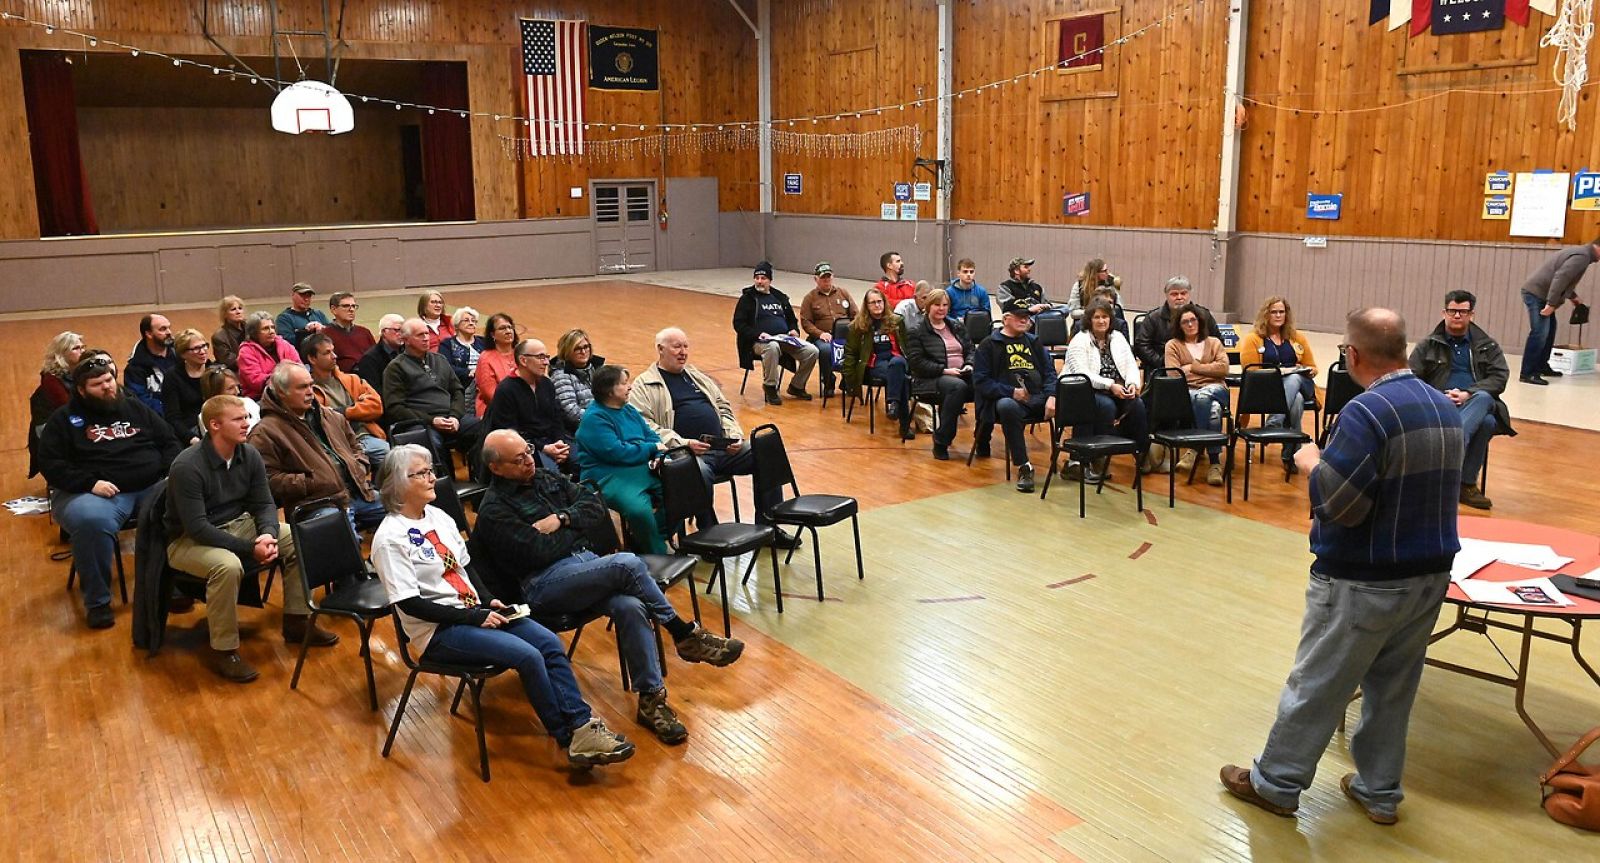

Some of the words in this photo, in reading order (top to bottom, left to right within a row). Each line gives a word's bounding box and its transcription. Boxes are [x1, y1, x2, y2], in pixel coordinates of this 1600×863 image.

[1074, 32, 1086, 55] C
[1006, 343, 1032, 356] OWA
[90, 420, 137, 443] 支配
